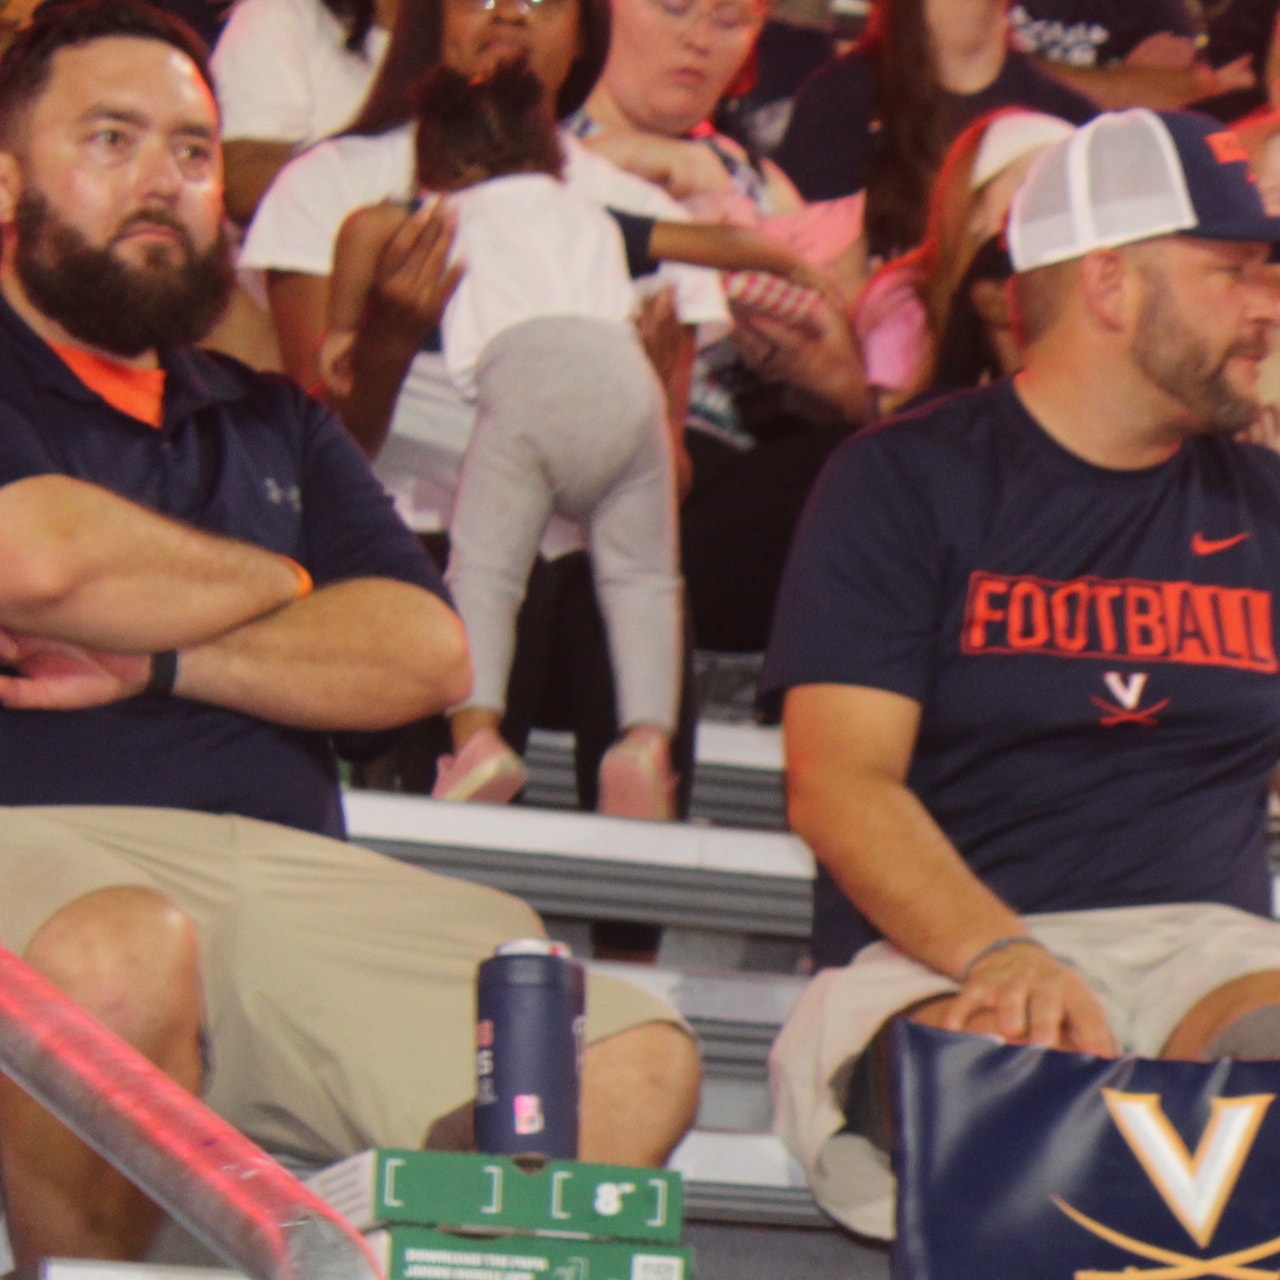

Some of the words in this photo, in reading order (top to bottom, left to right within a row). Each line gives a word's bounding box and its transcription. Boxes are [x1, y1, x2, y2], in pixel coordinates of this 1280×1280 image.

[967, 576, 1275, 670] FOOTBALL
[1103, 671, 1149, 711] V
[1100, 1086, 1279, 1249] V
